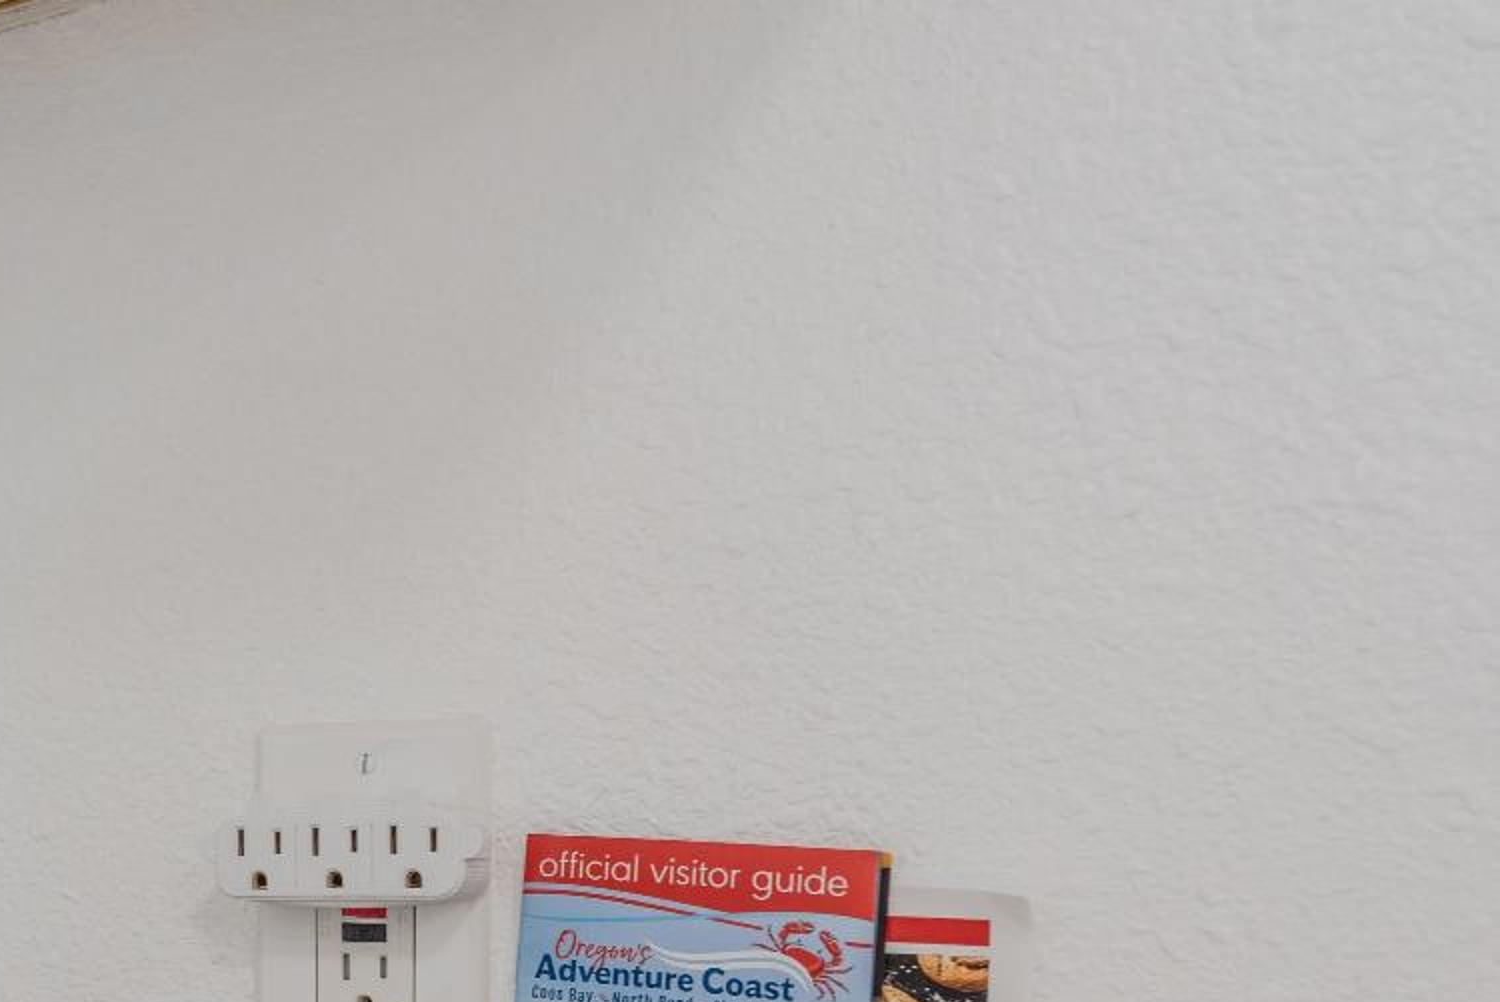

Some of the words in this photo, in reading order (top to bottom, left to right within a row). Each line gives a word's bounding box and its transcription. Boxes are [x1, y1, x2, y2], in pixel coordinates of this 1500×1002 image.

[539, 852, 638, 884] official
[650, 862, 739, 890] visitor
[752, 866, 850, 901] guide
[554, 929, 655, 973] Oregon's
[532, 984, 564, 1002] Coos
[535, 953, 693, 992] Adventure
[702, 966, 795, 1002] Coast
